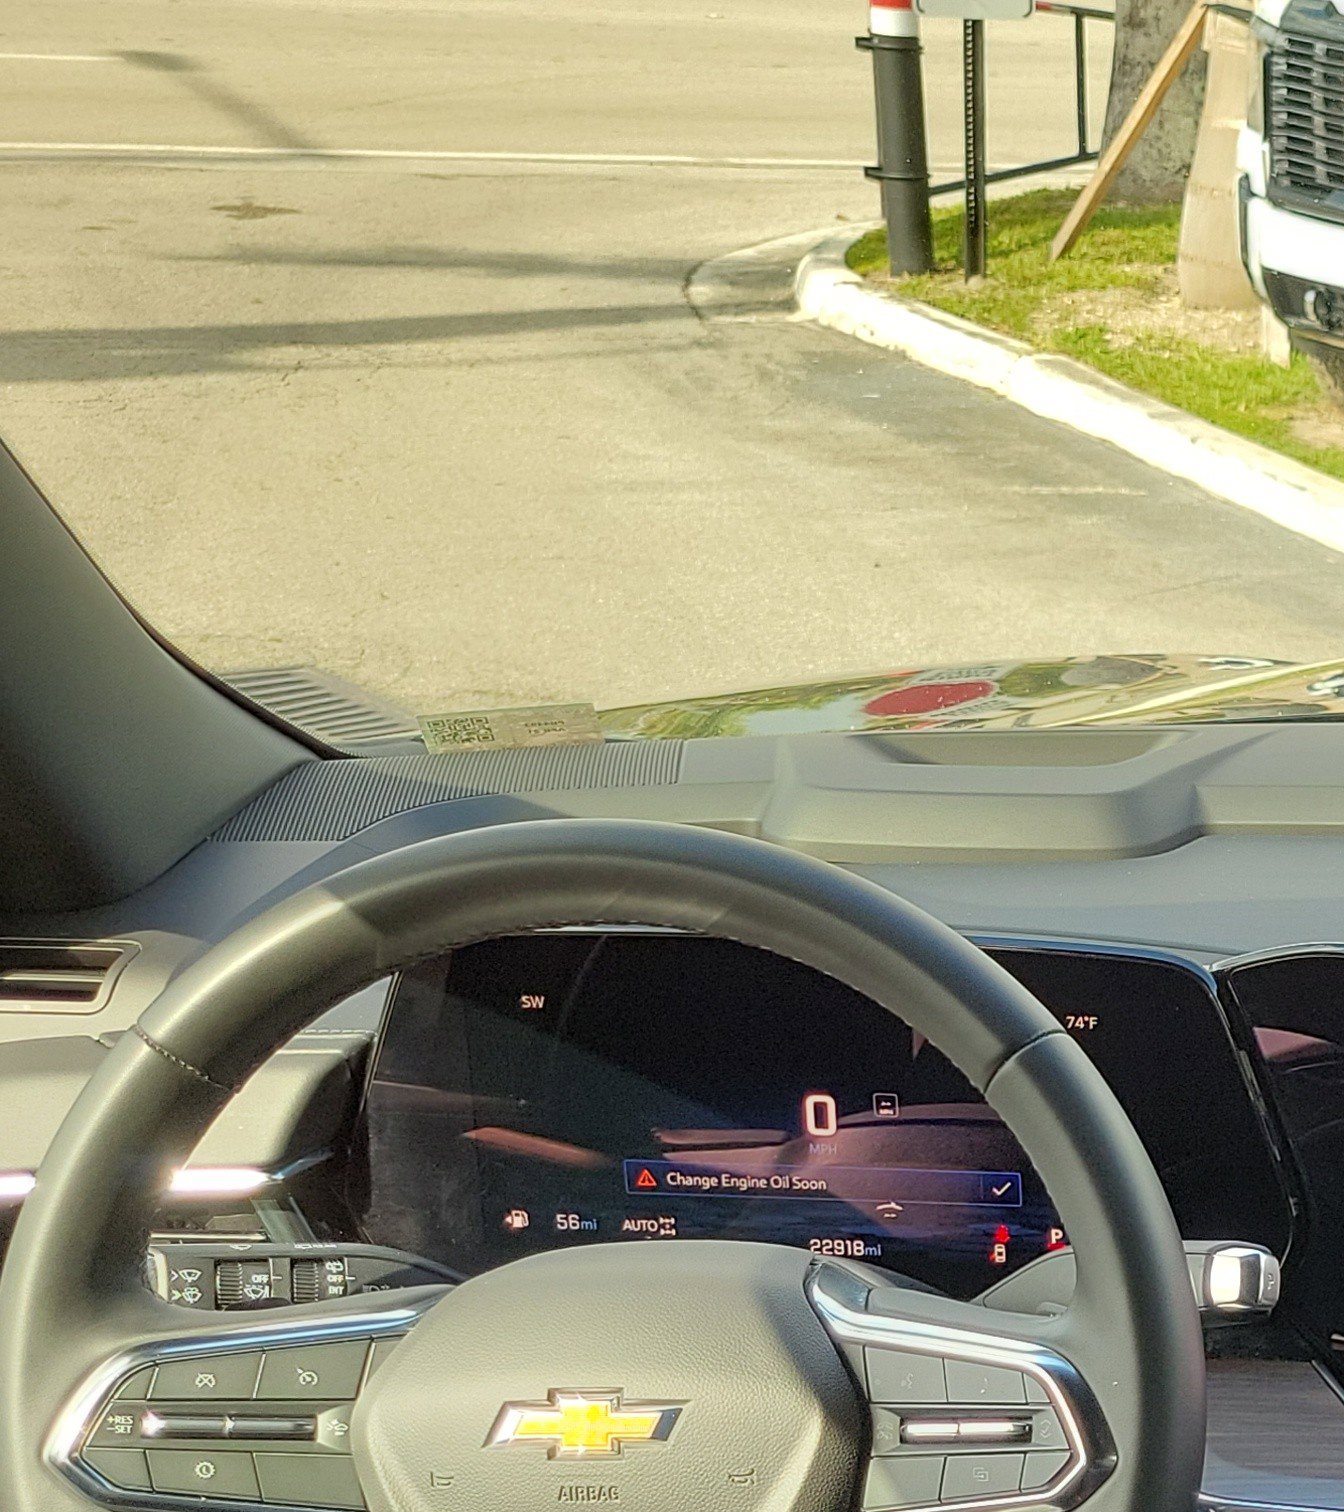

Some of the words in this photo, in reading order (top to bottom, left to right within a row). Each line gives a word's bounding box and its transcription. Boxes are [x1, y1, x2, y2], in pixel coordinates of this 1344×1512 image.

[521, 995, 545, 1009] SW
[1065, 1015, 1098, 1030] 74°F
[805, 1094, 837, 1136] 0
[809, 1143, 838, 1155] MPH
[666, 1171, 718, 1190] Change
[721, 1173, 768, 1191] Engine
[770, 1175, 790, 1189] Oil
[792, 1176, 827, 1191] Soon
[622, 1218, 658, 1233] AUTO
[1050, 1228, 1063, 1245] P
[251, 1274, 271, 1285] OFF
[557, 1482, 621, 1502] AIRBAG
